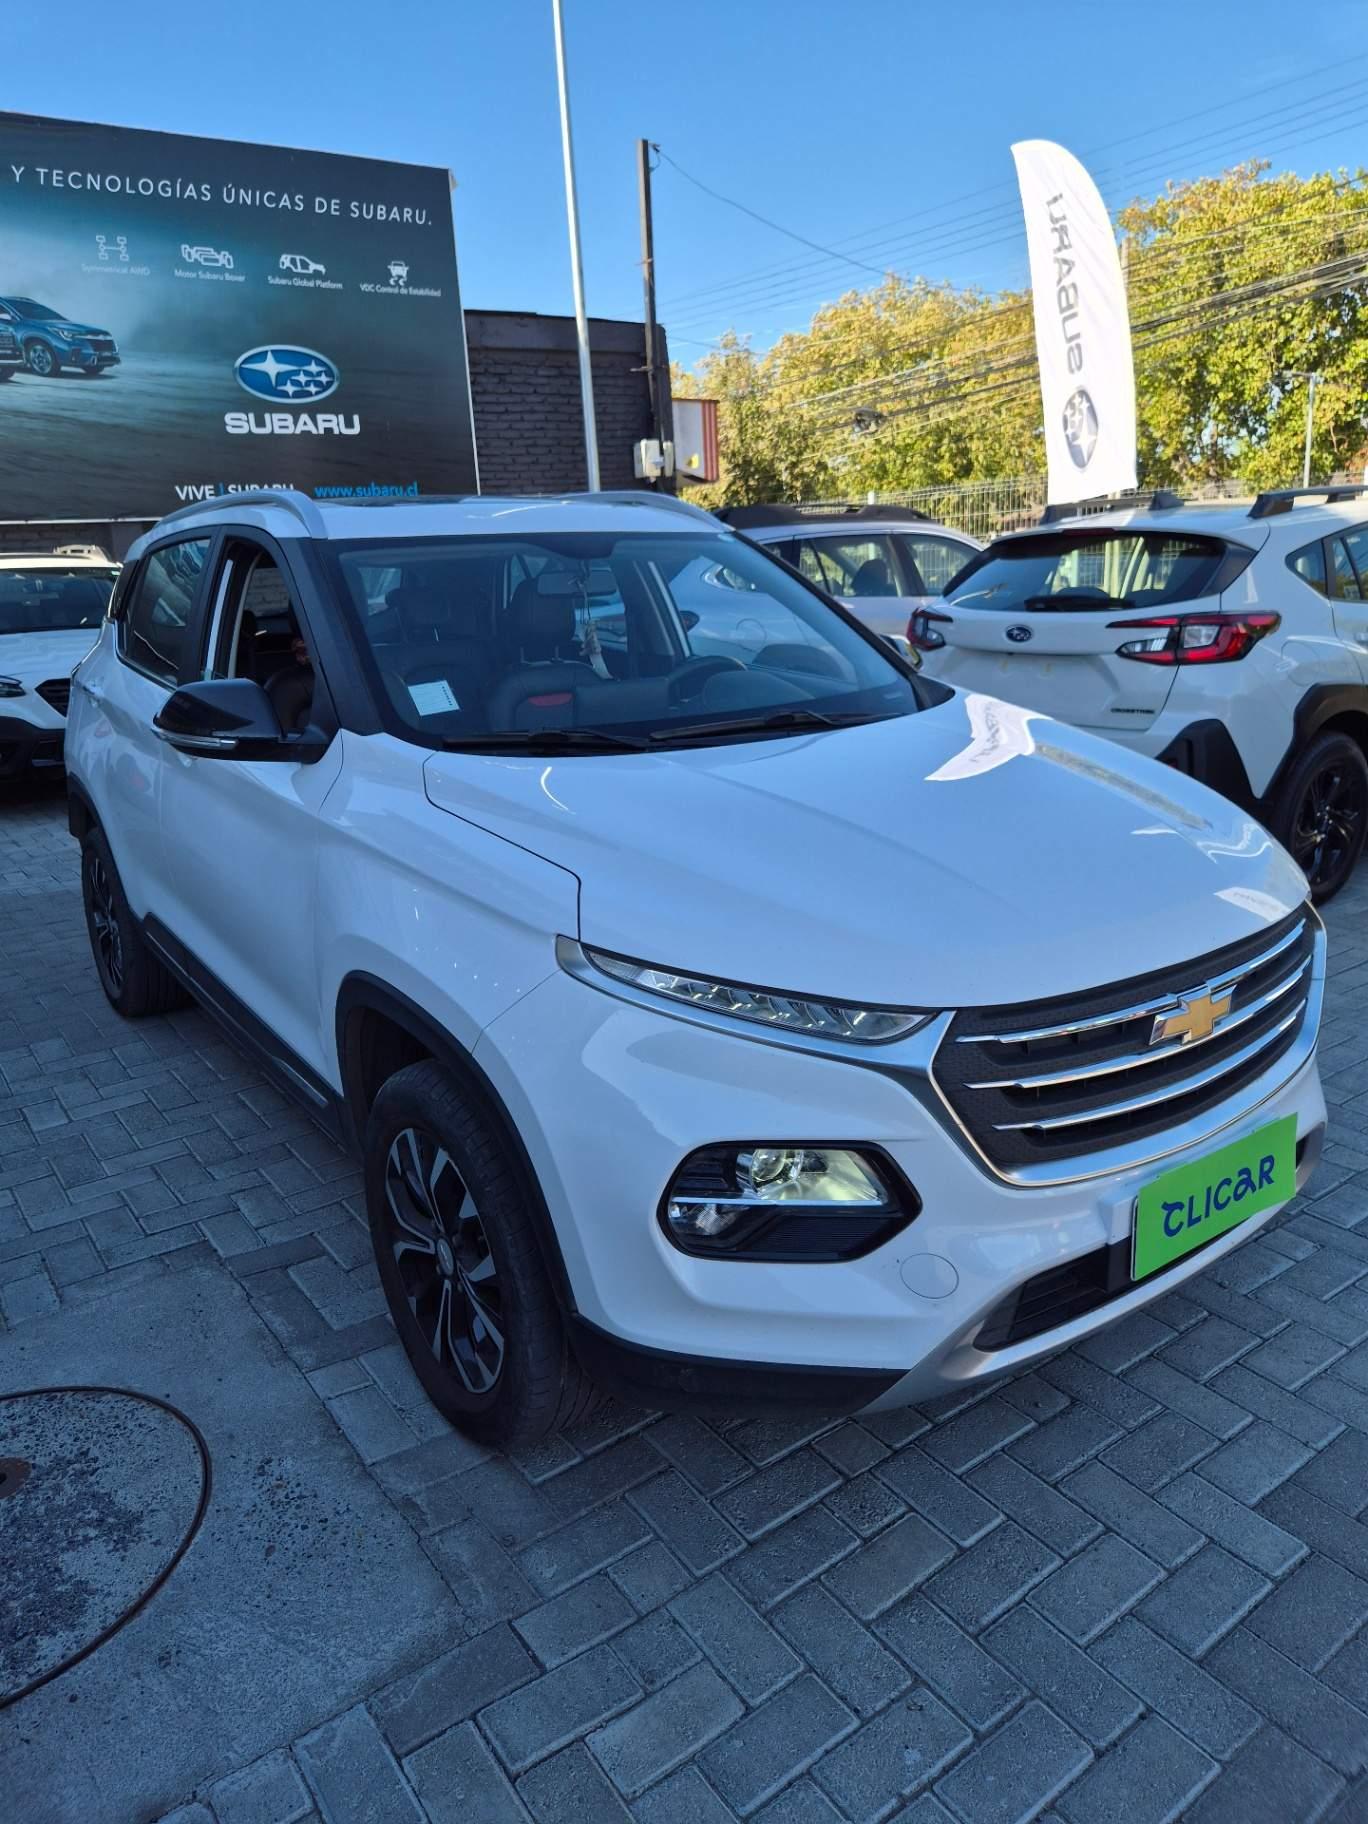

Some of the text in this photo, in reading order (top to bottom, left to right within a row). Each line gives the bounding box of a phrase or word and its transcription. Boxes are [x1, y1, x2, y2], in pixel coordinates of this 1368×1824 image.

[11, 165, 432, 226] Y TECNOLOGÍAS ÚNICAS DE SUBARU.
[198, 270, 224, 281] Subaru
[267, 275, 343, 290] Subaru Global Platform
[224, 412, 361, 435] SUBARU
[174, 484, 216, 501] VIVE
[314, 479, 419, 497] www.subaru.cl
